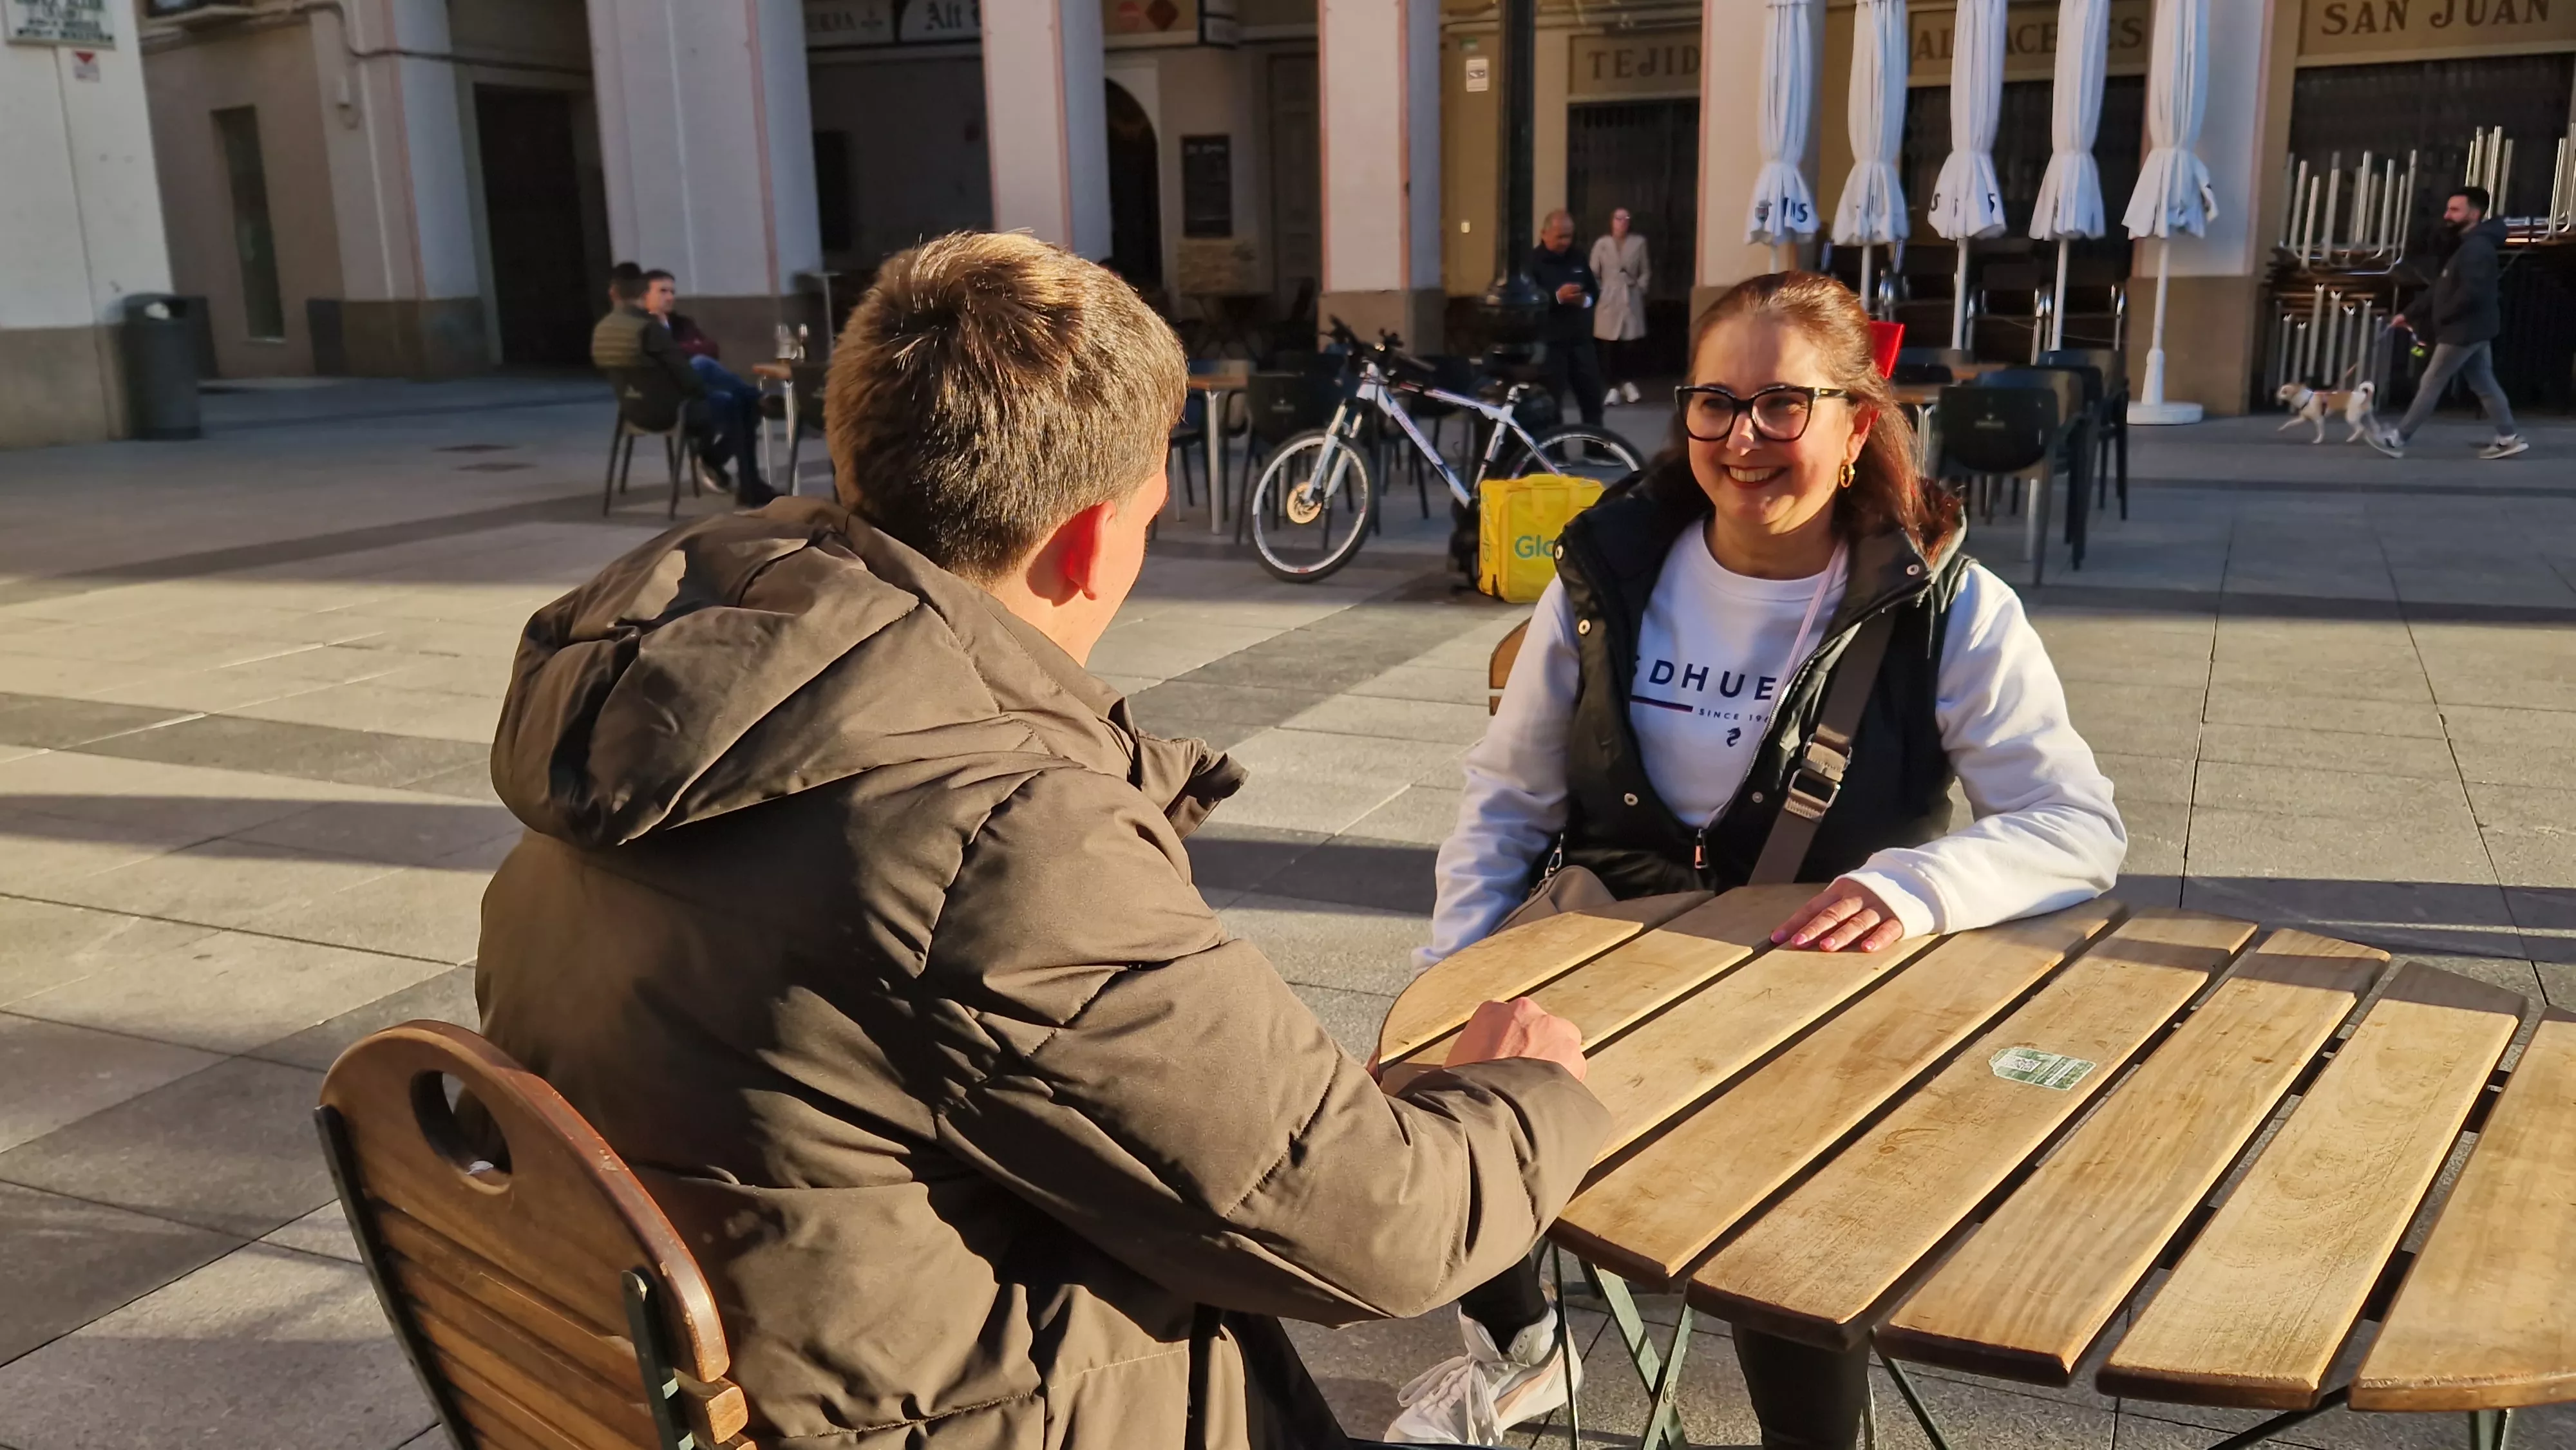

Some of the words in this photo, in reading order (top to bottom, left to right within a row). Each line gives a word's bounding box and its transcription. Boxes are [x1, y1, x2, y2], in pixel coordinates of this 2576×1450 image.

[2320, 0, 2410, 35] SAN
[2429, 0, 2550, 29] JUAN
[1634, 655, 1777, 701] DHUE
[1698, 708, 1739, 720] SINCE
